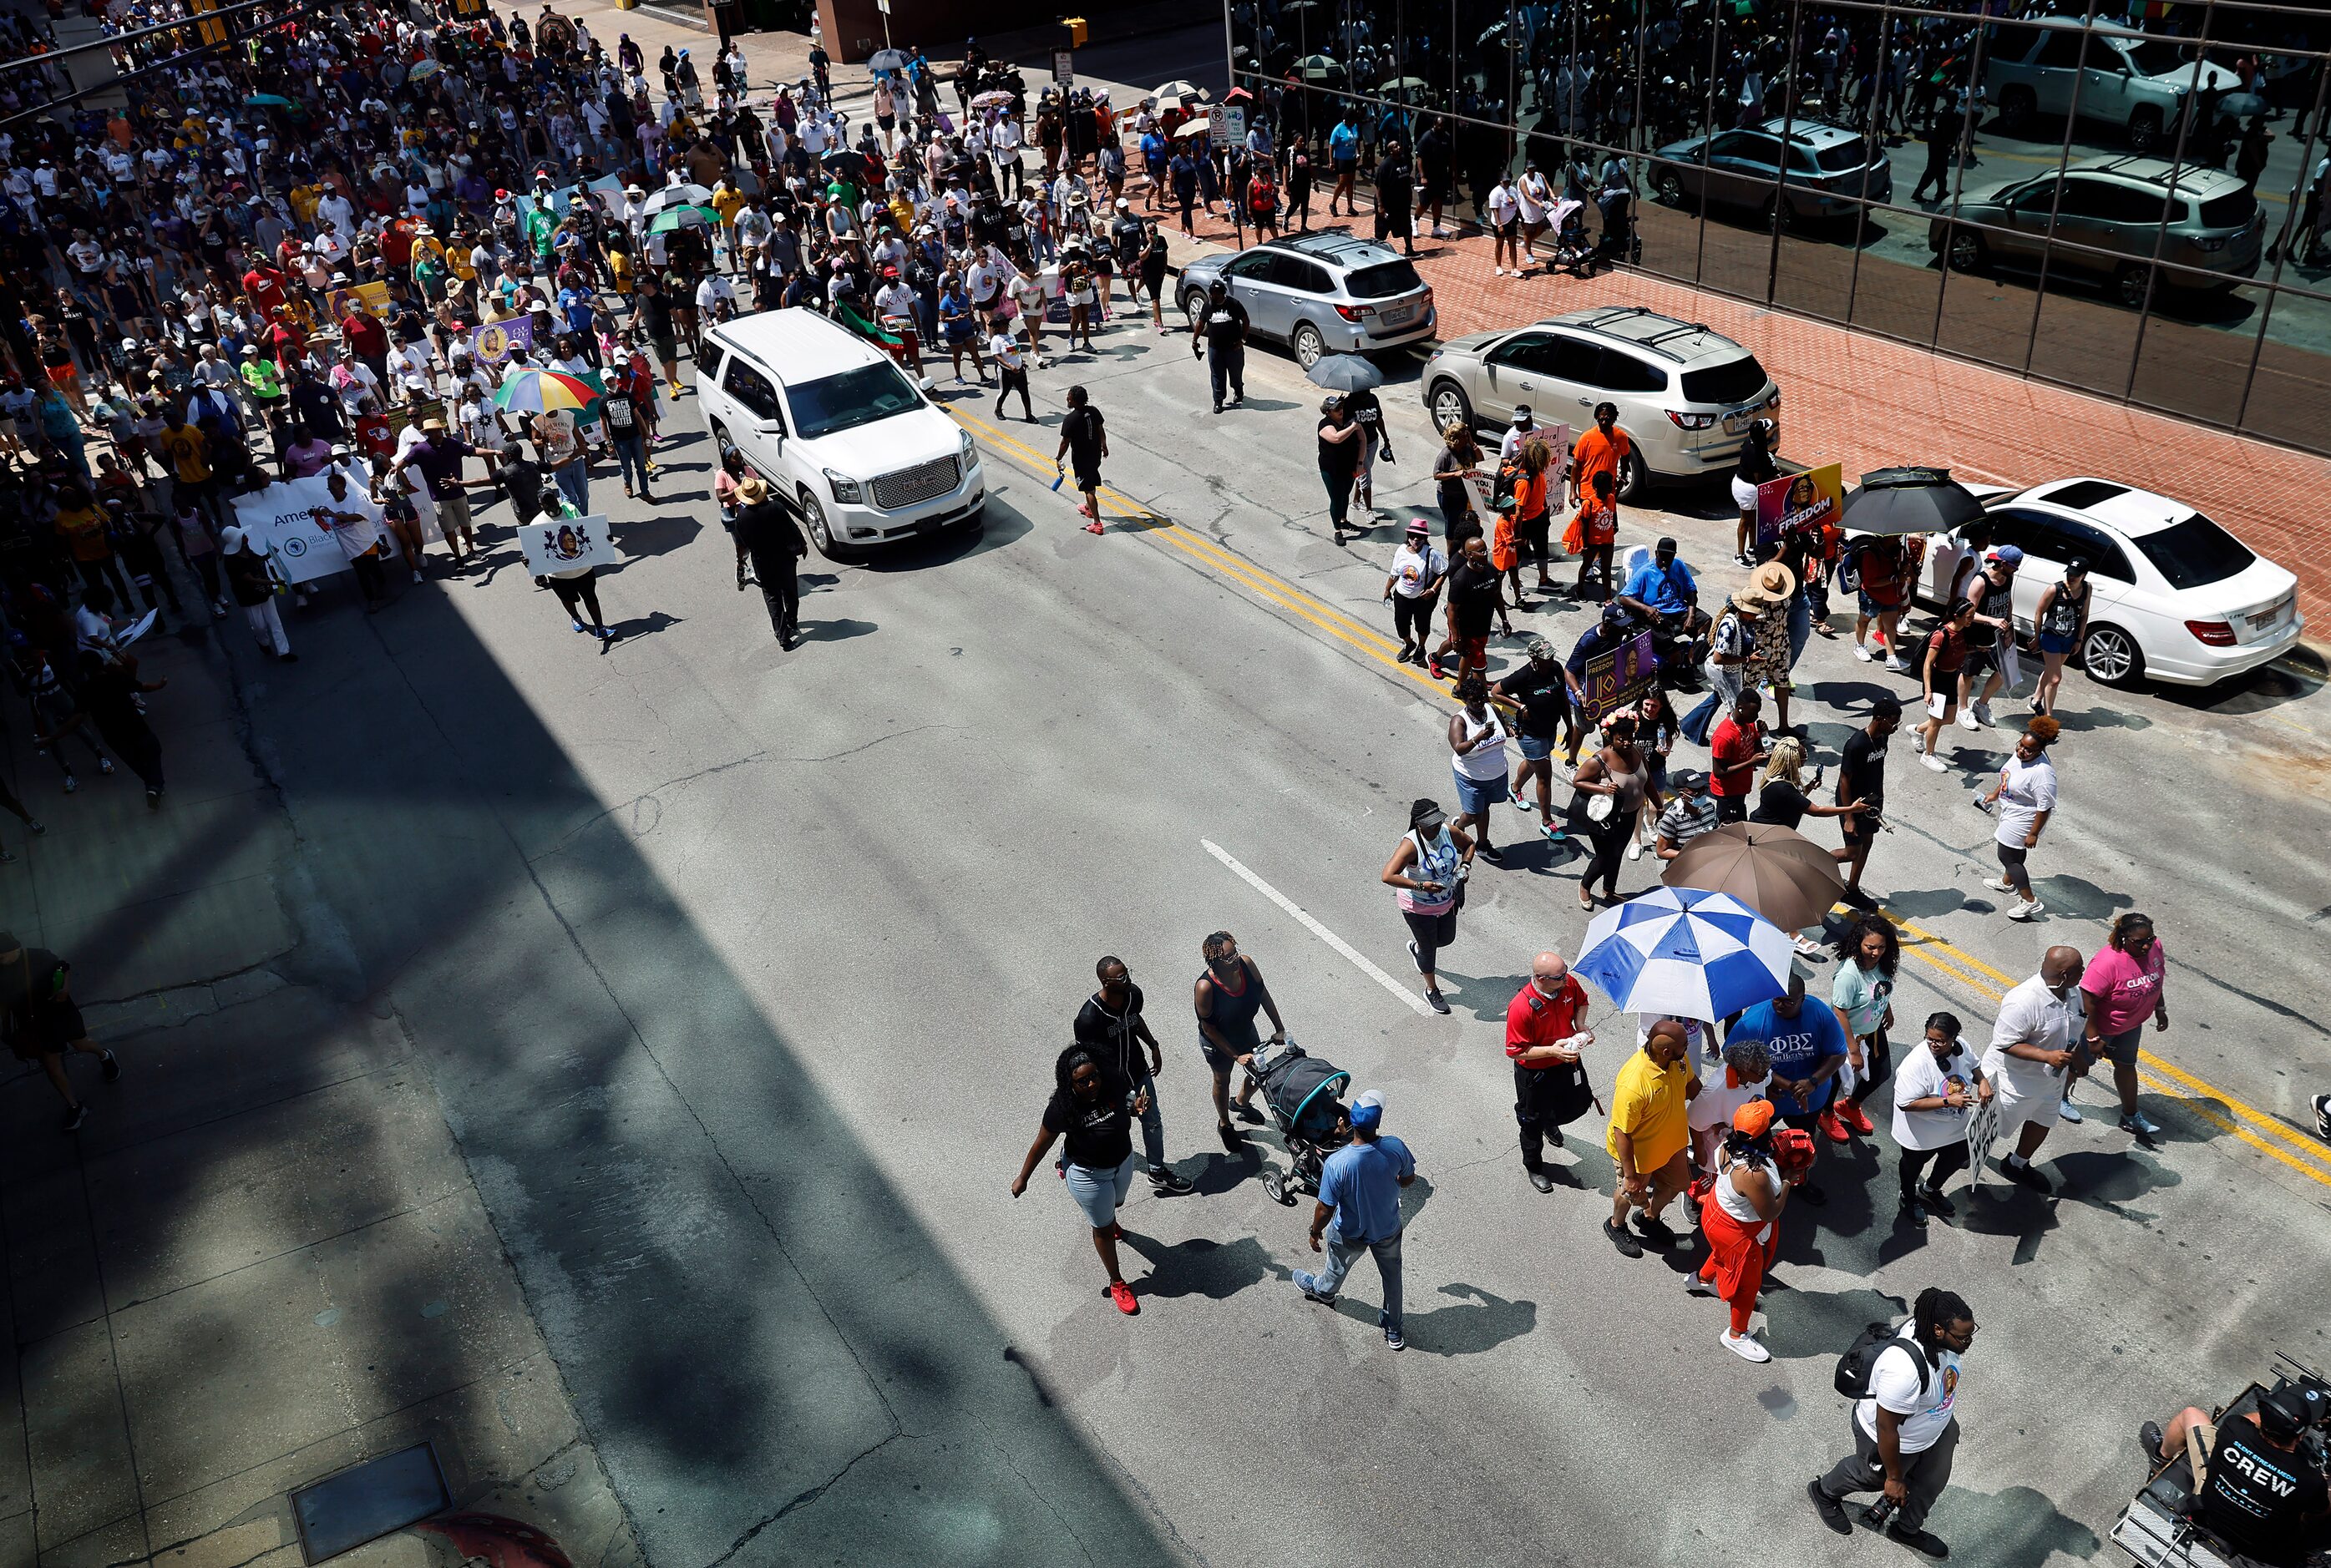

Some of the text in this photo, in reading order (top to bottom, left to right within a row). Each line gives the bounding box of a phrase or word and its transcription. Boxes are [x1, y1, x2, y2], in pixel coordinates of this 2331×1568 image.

[610, 408, 631, 418] VOTERS
[611, 417, 633, 426] MATTER
[903, 476, 935, 491] GMC
[308, 534, 336, 544] Black
[1588, 660, 1614, 675] FREEDOM
[2126, 971, 2161, 989] CLAYTON
[1107, 1012, 1138, 1038] DALLAS
[1983, 1121, 1998, 1162] DC
[2232, 1440, 2297, 1484] SILENT STREAM MEDIA
[2223, 1447, 2297, 1498] CREW
